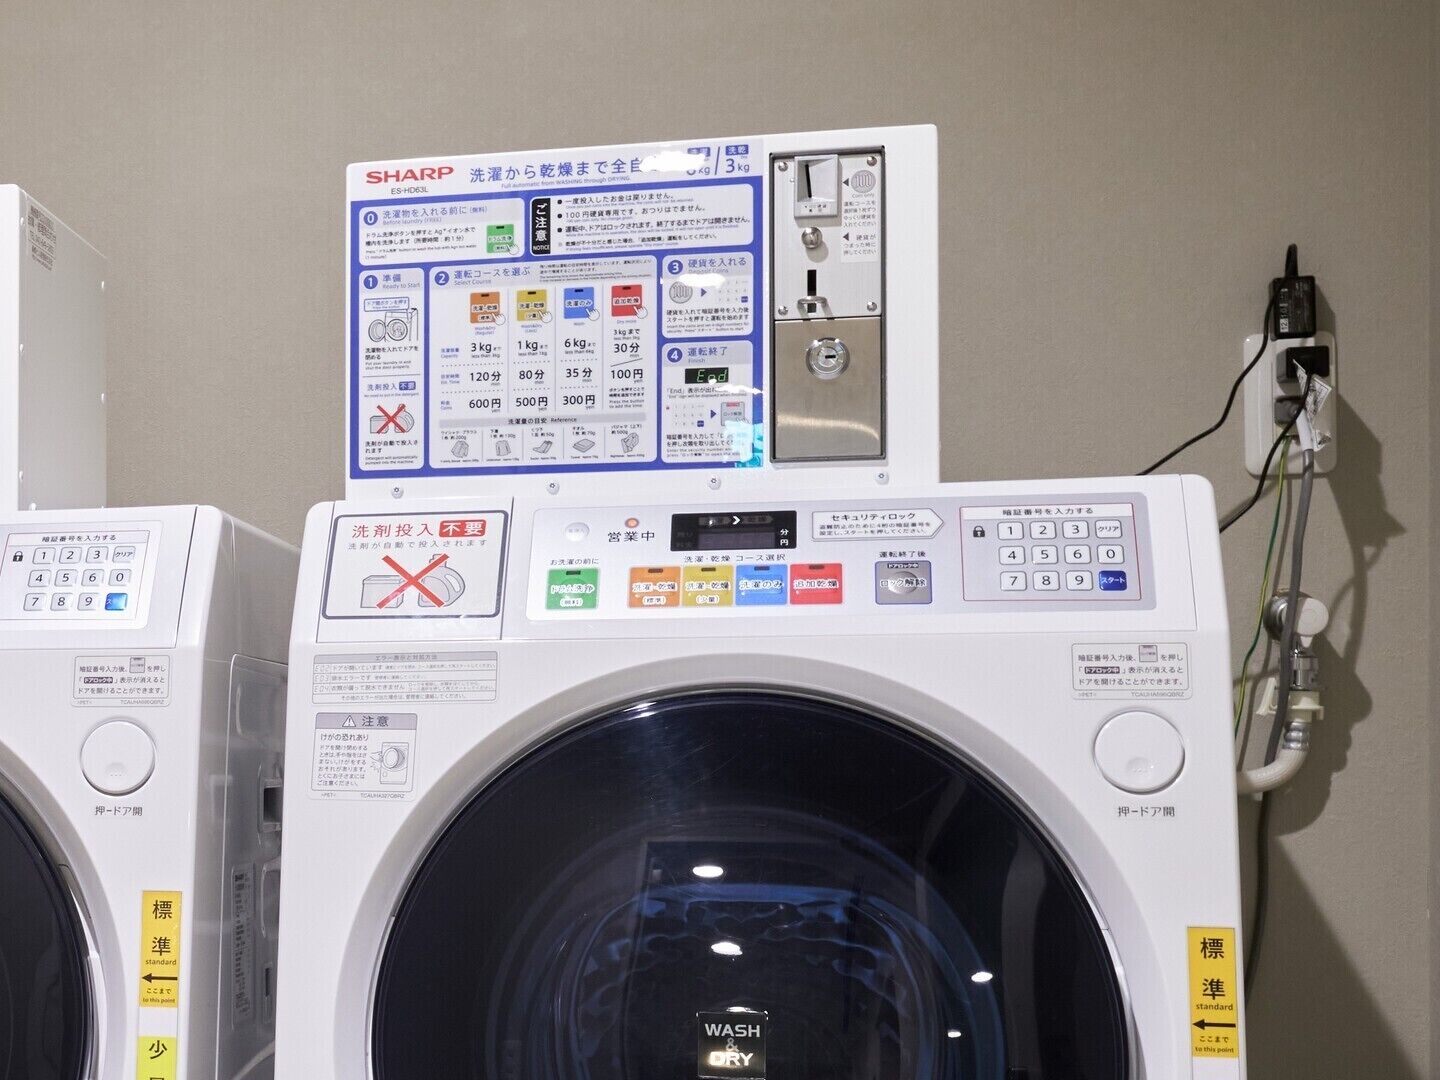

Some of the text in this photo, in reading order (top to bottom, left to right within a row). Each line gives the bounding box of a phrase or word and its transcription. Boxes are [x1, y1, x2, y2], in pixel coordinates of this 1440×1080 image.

[366, 166, 454, 184] SHARP
[470, 156, 658, 184] 洗濯から乾燥まで全自
[390, 187, 429, 195] ES-HD63L
[383, 206, 467, 220] 洗濯物を入れる前に
[535, 202, 547, 242] ご注意
[688, 257, 747, 268] 硬貨を入れる
[383, 273, 401, 283] 準備
[454, 266, 531, 280] 運転コースを選ぶ
[688, 346, 728, 356] 運転終了
[831, 512, 917, 522] セキュリティロック
[1002, 507, 1094, 516] 暗証番号を入力する
[351, 521, 486, 539] 洗剤投入 不要
[780, 528, 790, 536] 分
[1007, 525, 1120, 535] 1 2 3 クリア
[41, 534, 117, 543] 暗証番号を入力する
[607, 530, 656, 543] 営業中
[780, 538, 789, 546] 円
[41, 550, 133, 560] 1 2 3 クリア
[879, 550, 926, 558] 運転終了後
[1007, 549, 1116, 560] 4 5 6 0
[35, 572, 124, 583] 4 5 6 0
[1009, 575, 1126, 586] 7 8 9 スタート
[31, 596, 93, 607] 7 8 9
[361, 715, 389, 727] 注意
[320, 733, 369, 742] けがの恐れあり
[146, 987, 172, 995] ここまで
[1196, 1003, 1233, 1011] standard
[704, 1023, 761, 1038] WASH
[1199, 1035, 1229, 1043] ここまで
[725, 1037, 740, 1053] &
[709, 1051, 754, 1067] DRY
